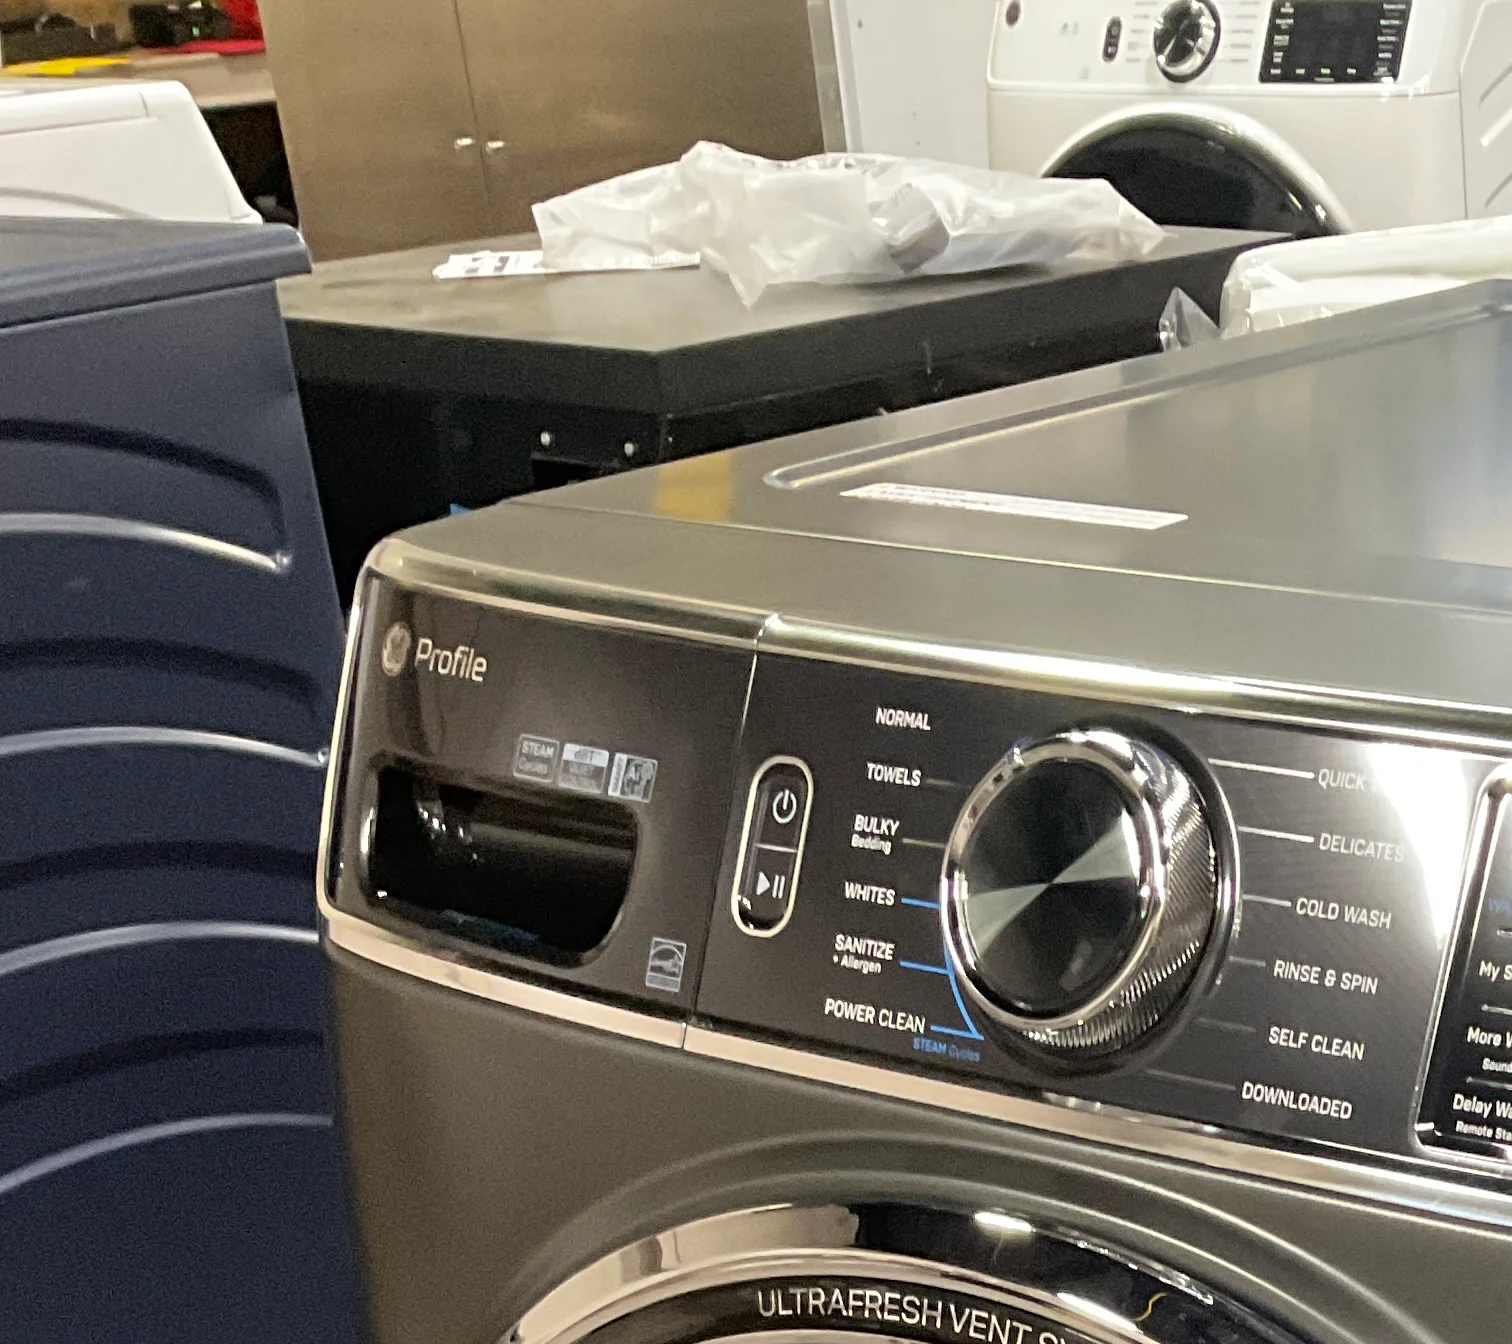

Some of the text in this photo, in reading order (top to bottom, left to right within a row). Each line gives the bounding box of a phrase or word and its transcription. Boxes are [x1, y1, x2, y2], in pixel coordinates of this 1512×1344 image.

[415, 636, 488, 682] Profile
[876, 707, 931, 731] NORMAL
[866, 763, 921, 787] TOWELS
[1318, 768, 1368, 791] QUICK
[854, 815, 899, 836] BULKY
[851, 834, 891, 855] Bedding
[1318, 832, 1404, 863] DELICATES
[844, 882, 895, 907] WHITES
[1296, 897, 1392, 930] COLD WASH
[835, 934, 895, 961] SANITIZE
[841, 953, 881, 975] Allergen
[1479, 960, 1501, 978] My
[1273, 959, 1378, 995] RINSE & SPIN
[825, 999, 926, 1035] POWER CLEAN
[1268, 1026, 1365, 1061] SELF CLEAN
[1467, 1026, 1502, 1047] More
[1242, 1081, 1353, 1120] DOWNLOADED
[1452, 1093, 1493, 1118] Delay
[1455, 1120, 1492, 1140] Remote
[757, 1286, 942, 1330] ULTRAFRESH
